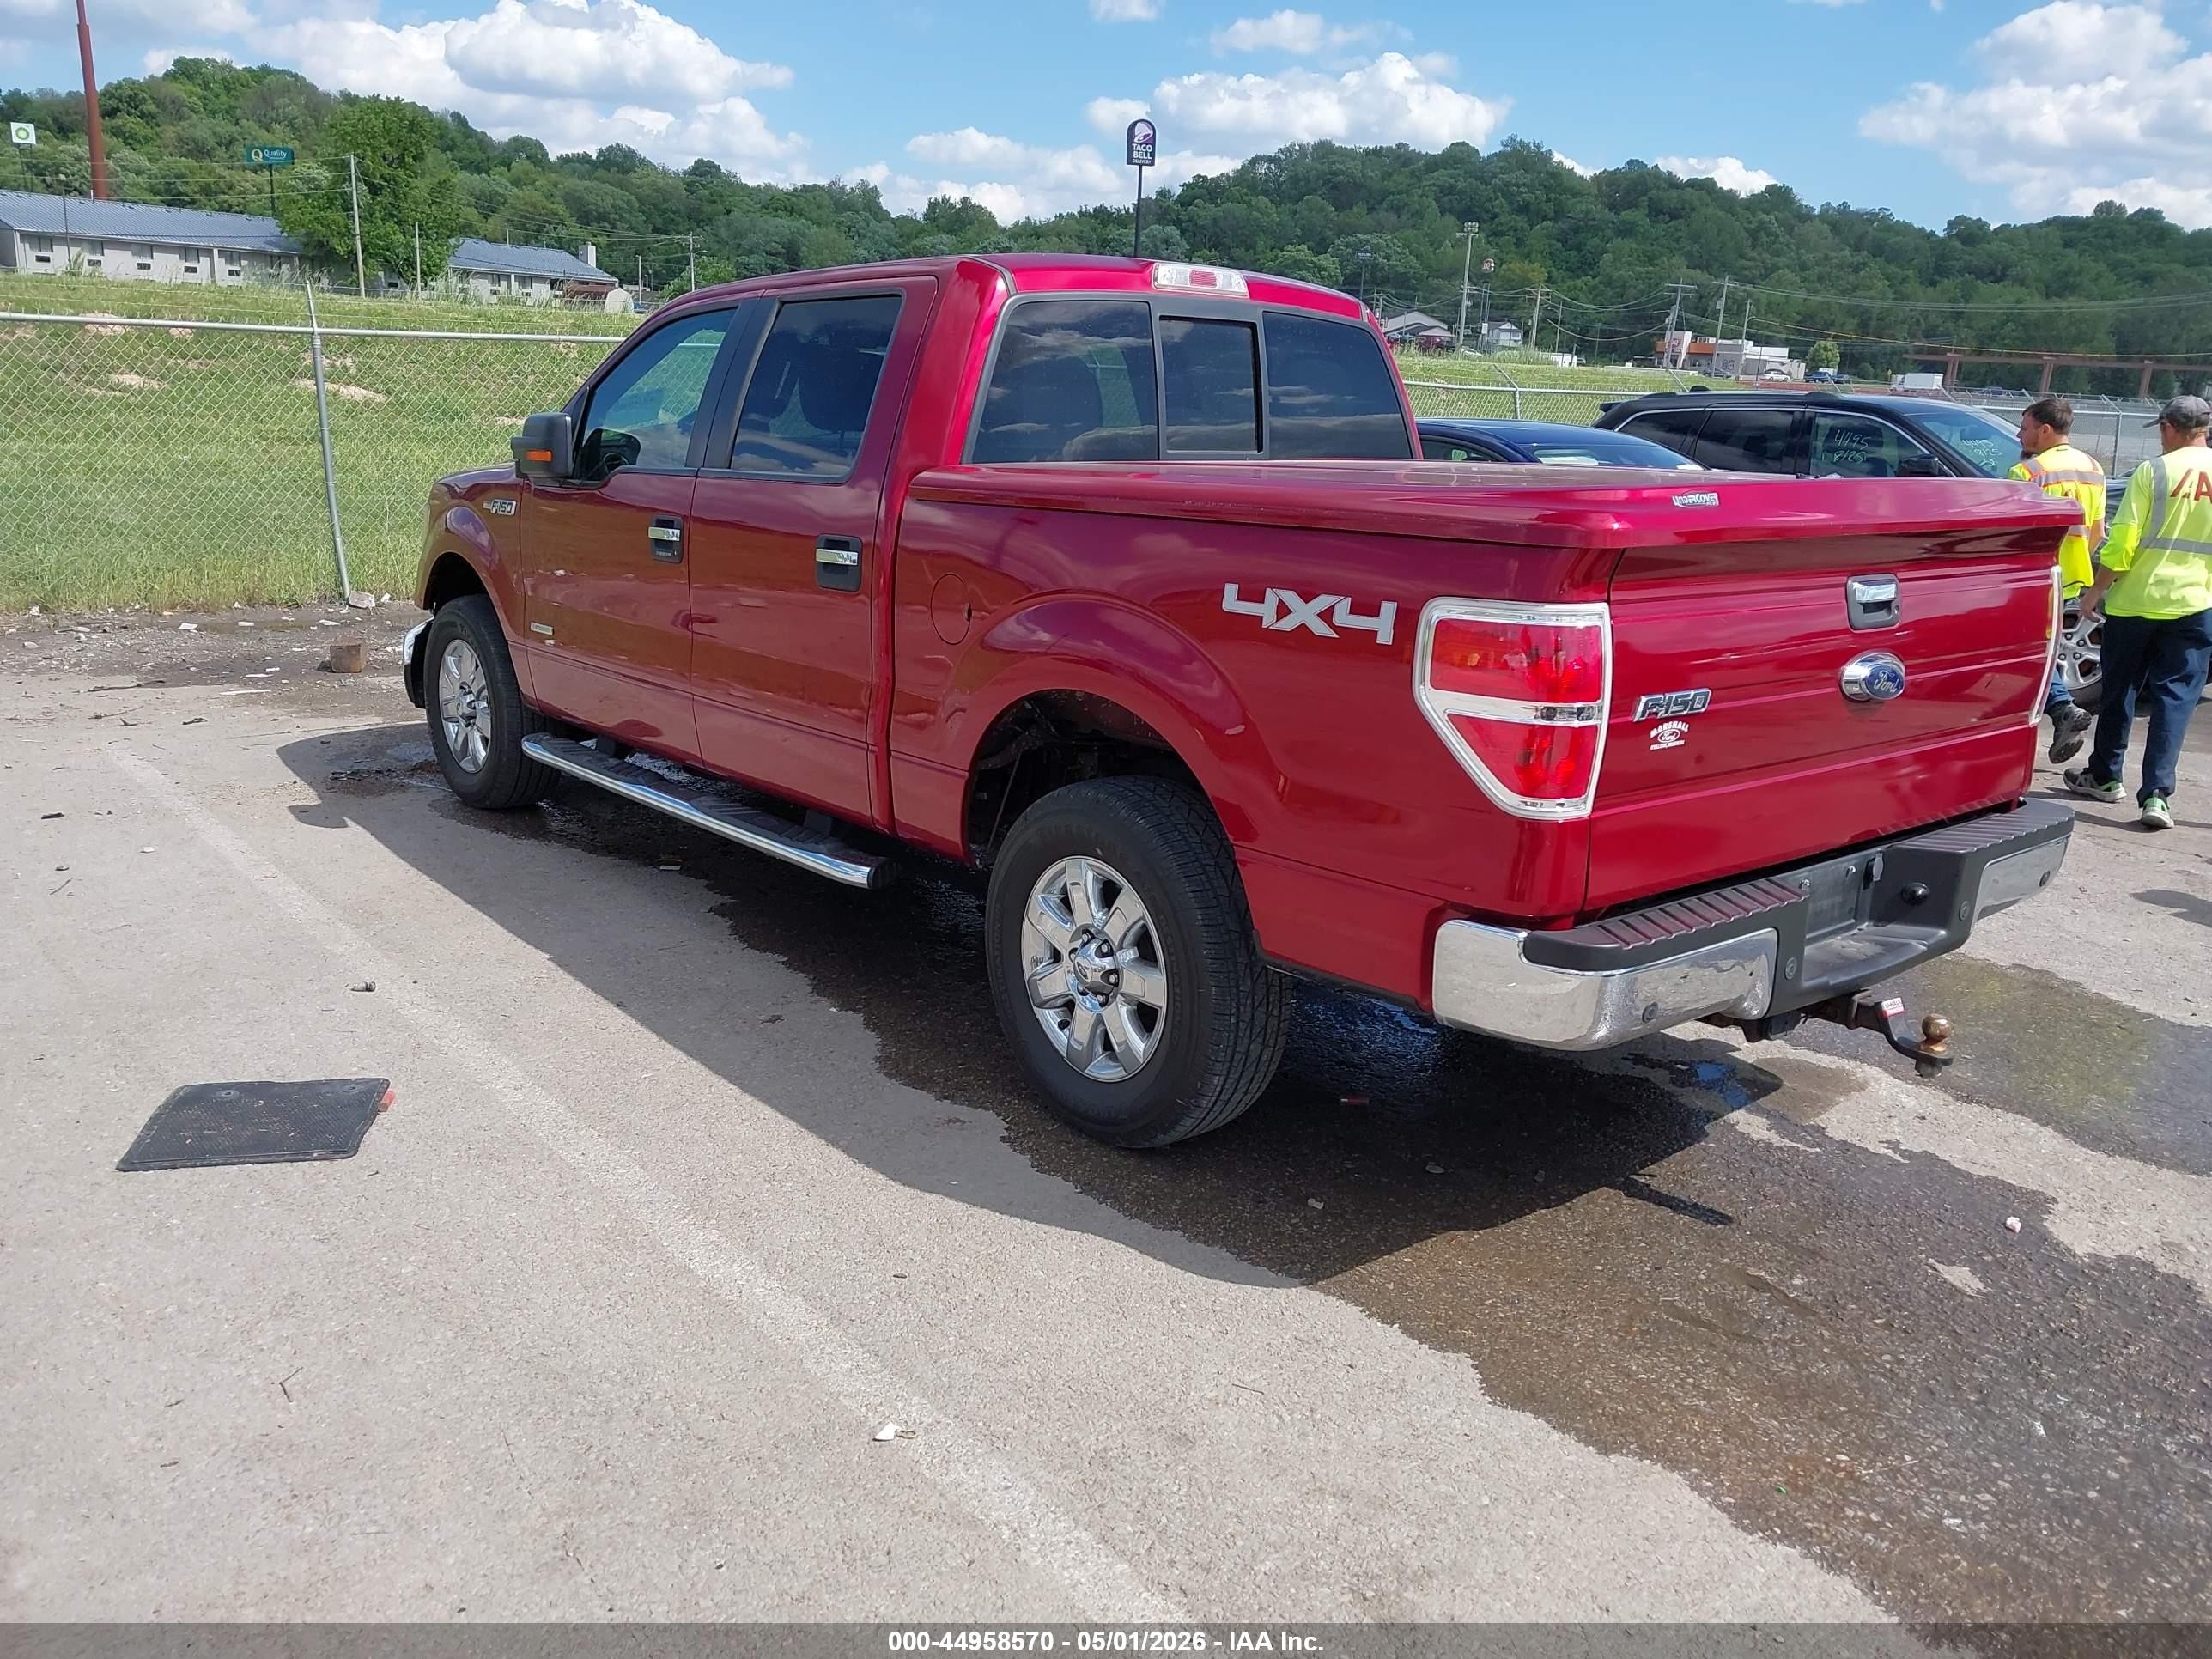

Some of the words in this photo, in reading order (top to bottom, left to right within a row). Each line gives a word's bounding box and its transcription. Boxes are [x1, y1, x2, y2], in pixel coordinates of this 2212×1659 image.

[264, 149, 287, 159] Quality
[1132, 143, 1152, 152] TACO
[1133, 150, 1152, 160] BELL
[1873, 670, 1900, 694] Ford
[1632, 688, 1711, 722] F-150
[1650, 720, 1689, 739] MARSHALL
